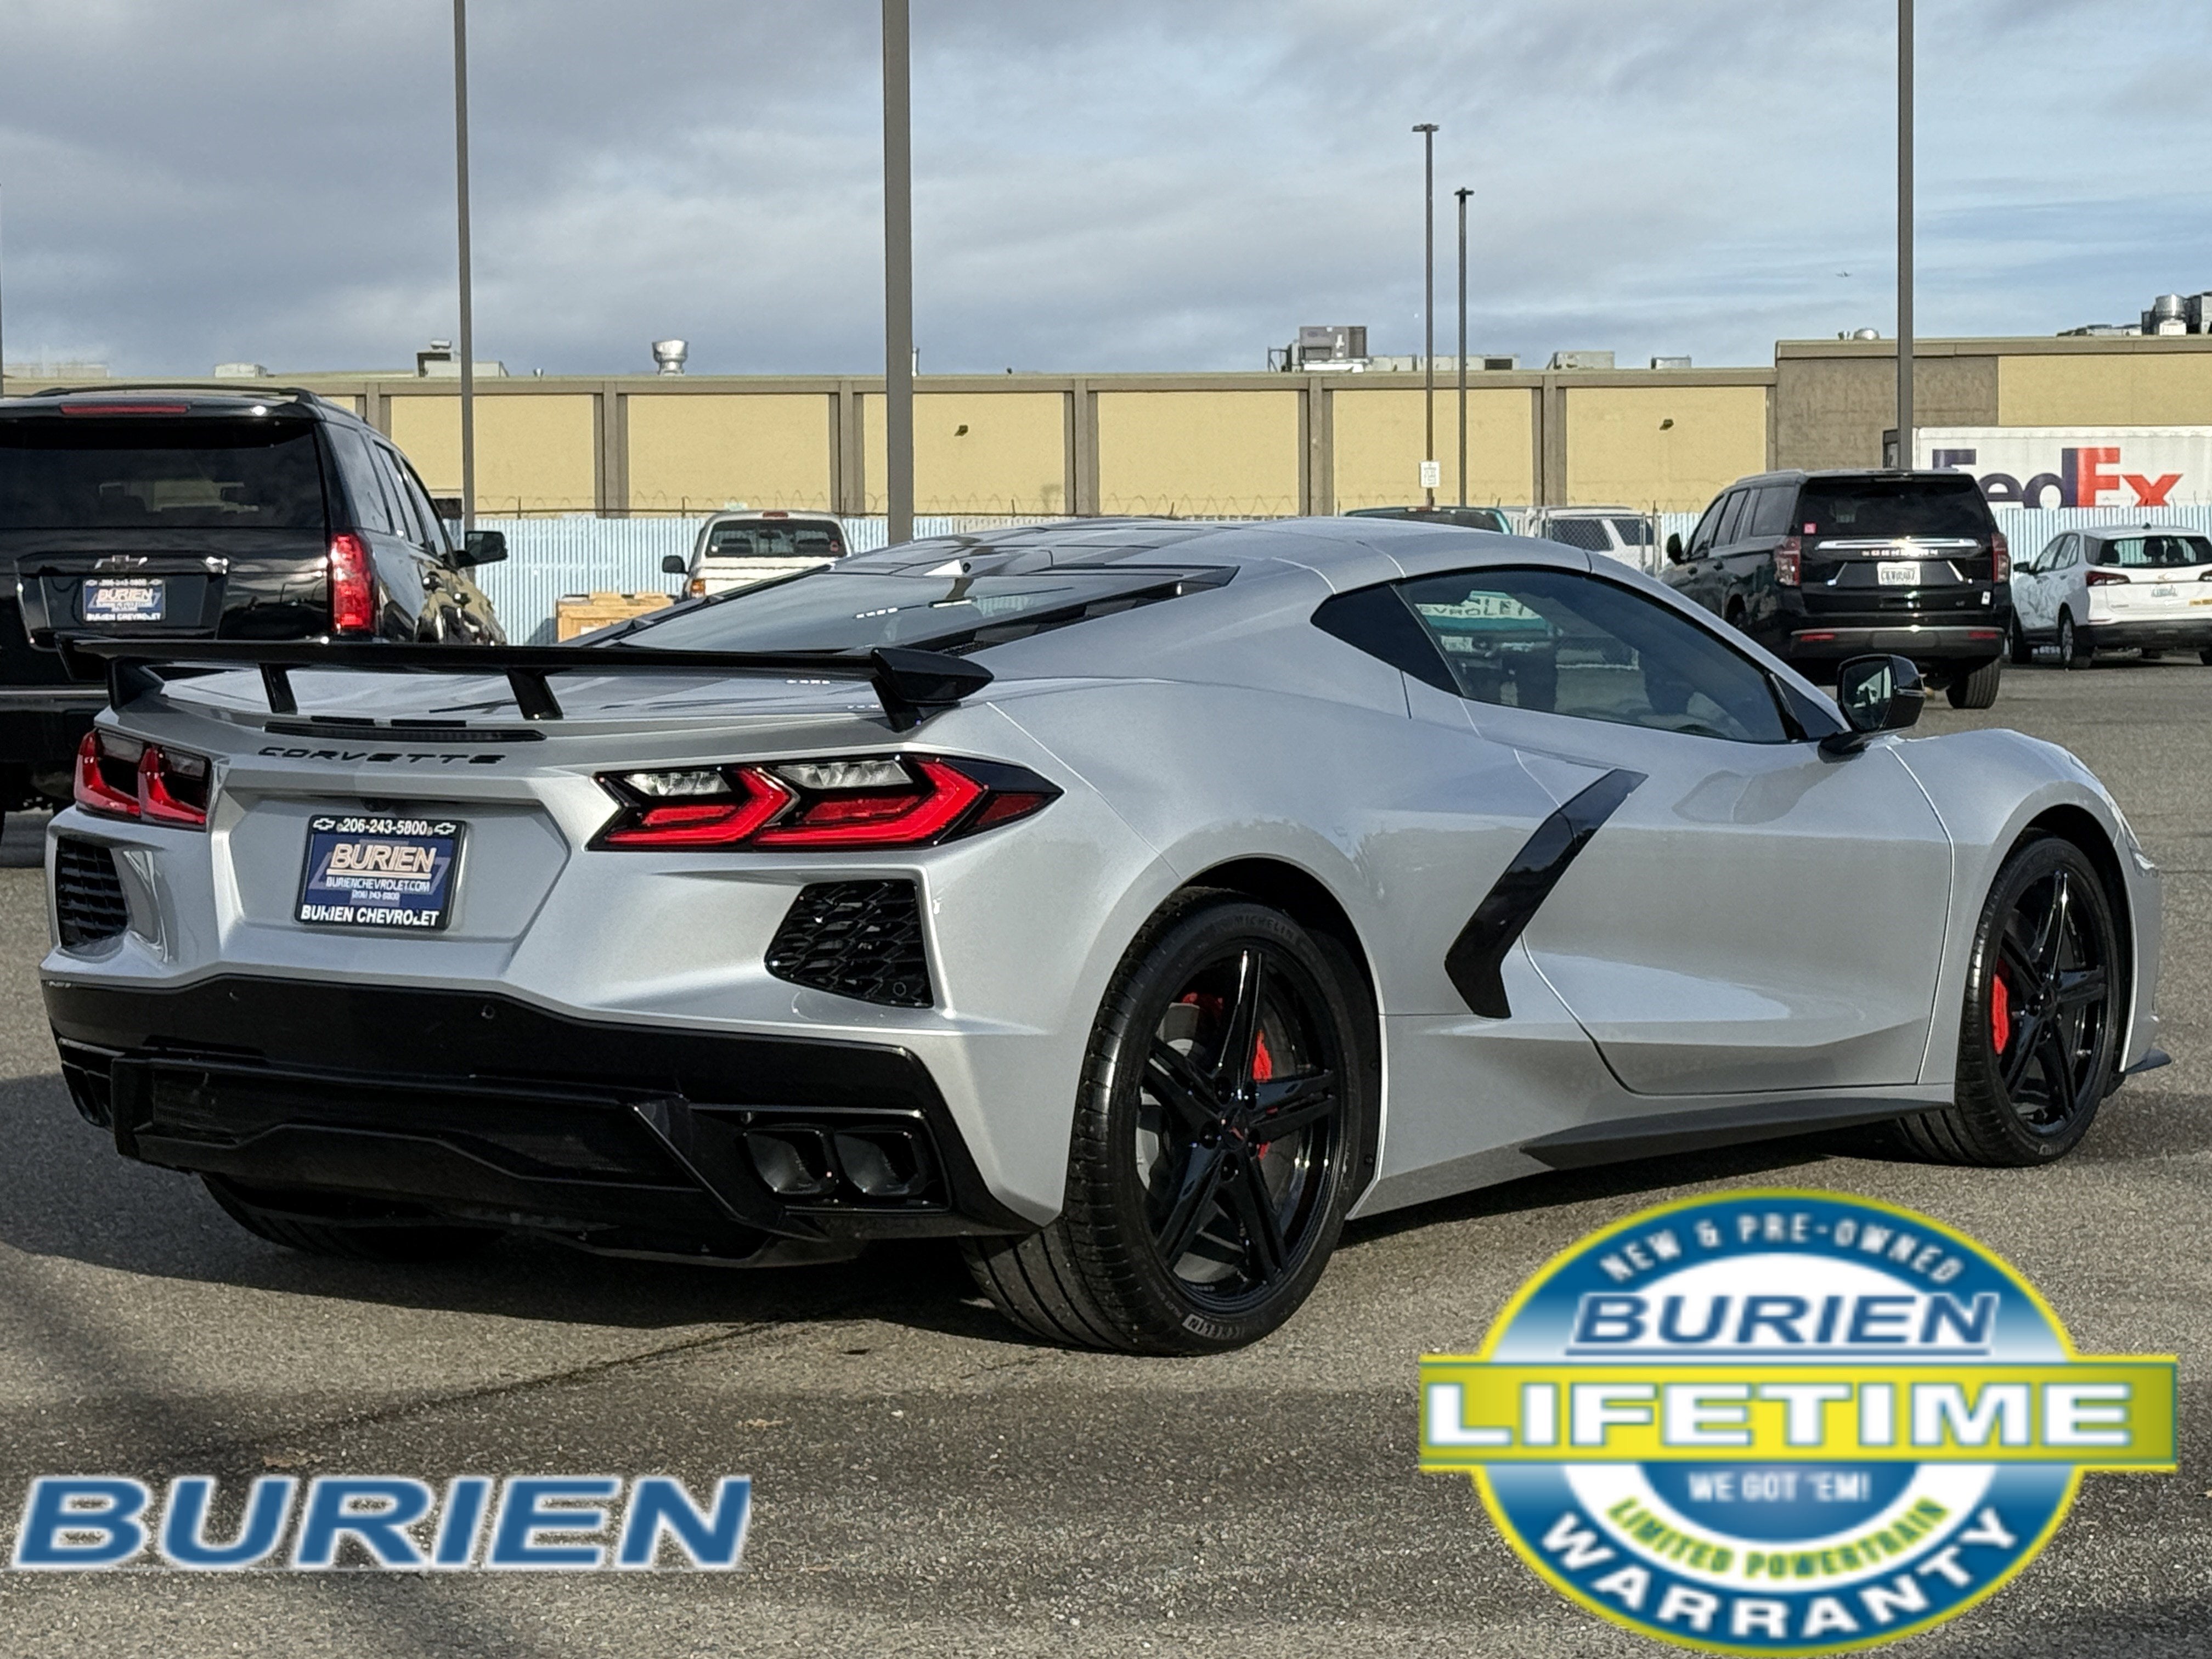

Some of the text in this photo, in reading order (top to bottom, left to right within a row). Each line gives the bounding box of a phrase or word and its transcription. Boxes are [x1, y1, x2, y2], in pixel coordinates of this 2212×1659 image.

[258, 747, 506, 764] CORVETTE
[342, 817, 427, 836] 206-243-5800
[331, 843, 437, 872] BURIEN
[326, 877, 430, 892] BURIENCHEVROLET.COM
